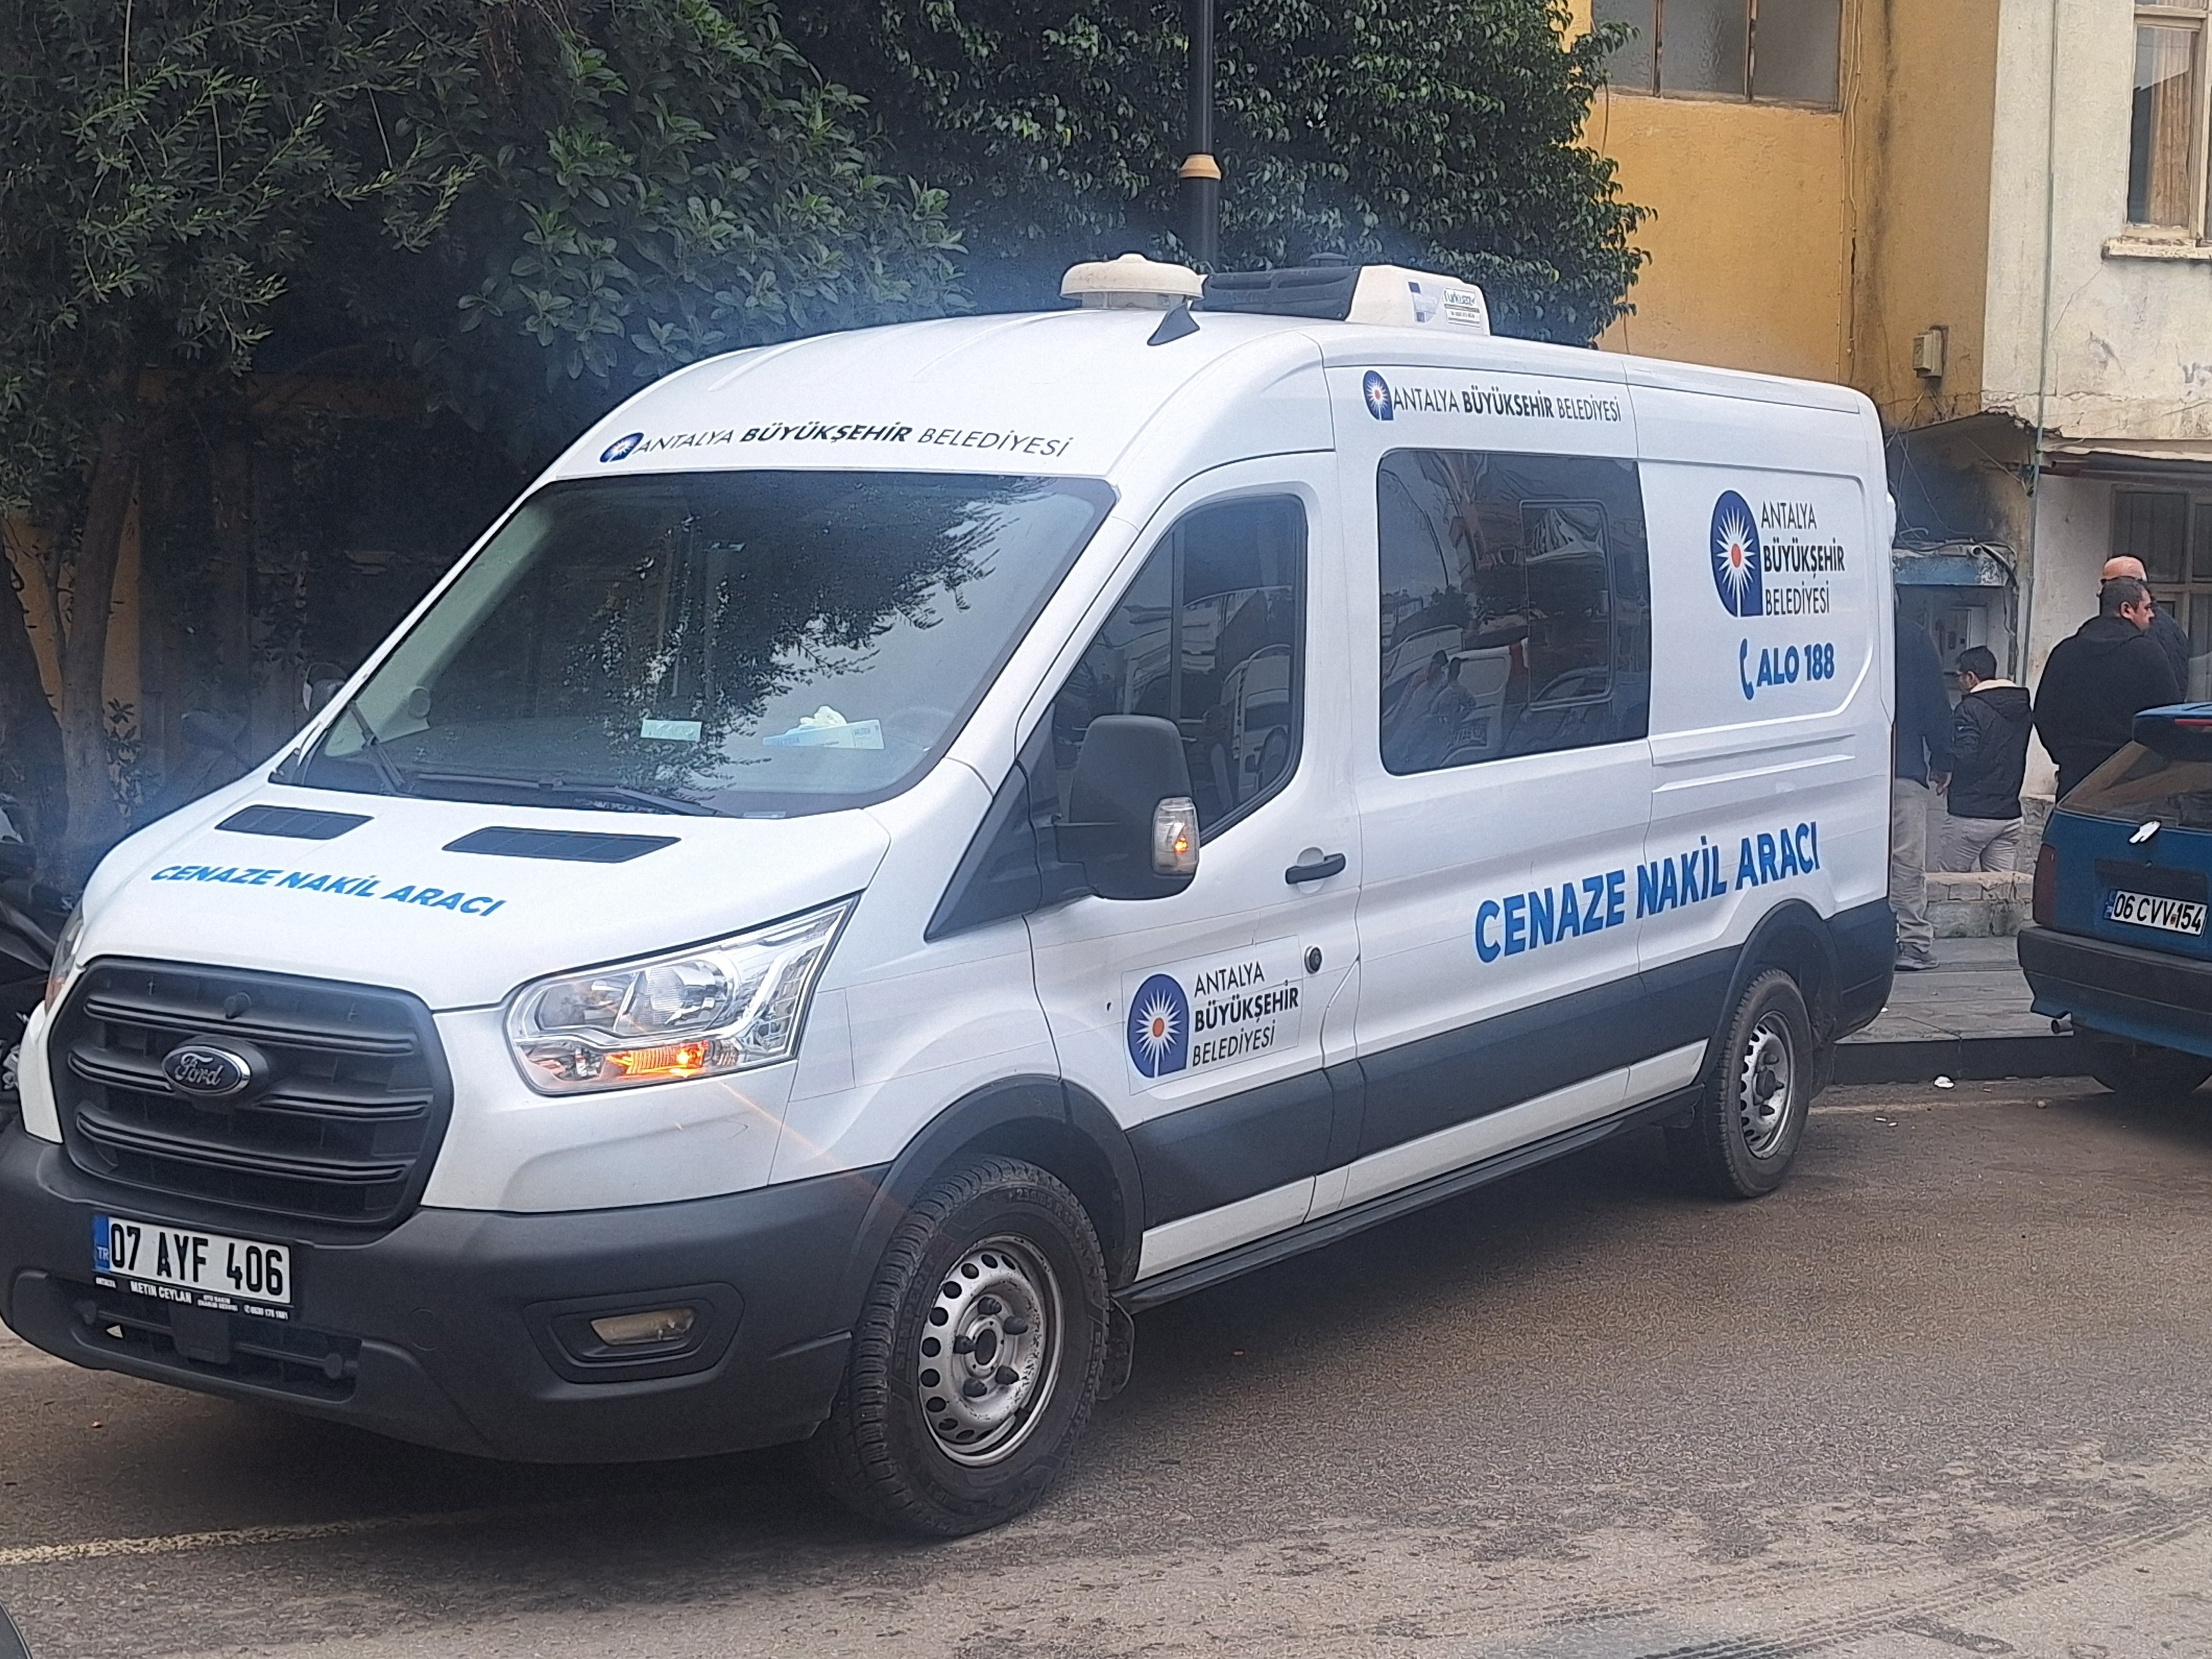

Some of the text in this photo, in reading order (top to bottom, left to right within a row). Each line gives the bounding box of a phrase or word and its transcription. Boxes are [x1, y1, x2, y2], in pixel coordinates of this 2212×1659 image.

[1393, 386, 1460, 413] ANTALYA
[1557, 394, 1621, 422] BELEDİYESİ
[634, 421, 1073, 457] ANTALYA BÜYÜKŞEHİR BELEDİYESİ
[1761, 501, 1817, 529] ANTALYA
[1763, 537, 1845, 579] BÜYÜKŞEHİR
[1765, 581, 1830, 615] BELEDİYESİ
[1757, 642, 1834, 687] ALO 188
[150, 866, 507, 916] CENAZE NAKİL ARACI
[1476, 821, 1820, 963] CENAZE NAKİL ARACI
[2113, 893, 2135, 920] 06
[2137, 898, 2175, 926] CVV
[2175, 903, 2203, 932] 154
[1194, 961, 1265, 998] ANTALYA
[1195, 979, 1299, 1033] BÜYÜKŞEHİR
[1193, 1019, 1276, 1068] BELEDİYESİ
[174, 1052, 224, 1086] Ford
[97, 1245, 109, 1261] TR
[111, 1223, 283, 1296] 07 AYF 406
[158, 1286, 192, 1304] CEYLAN
